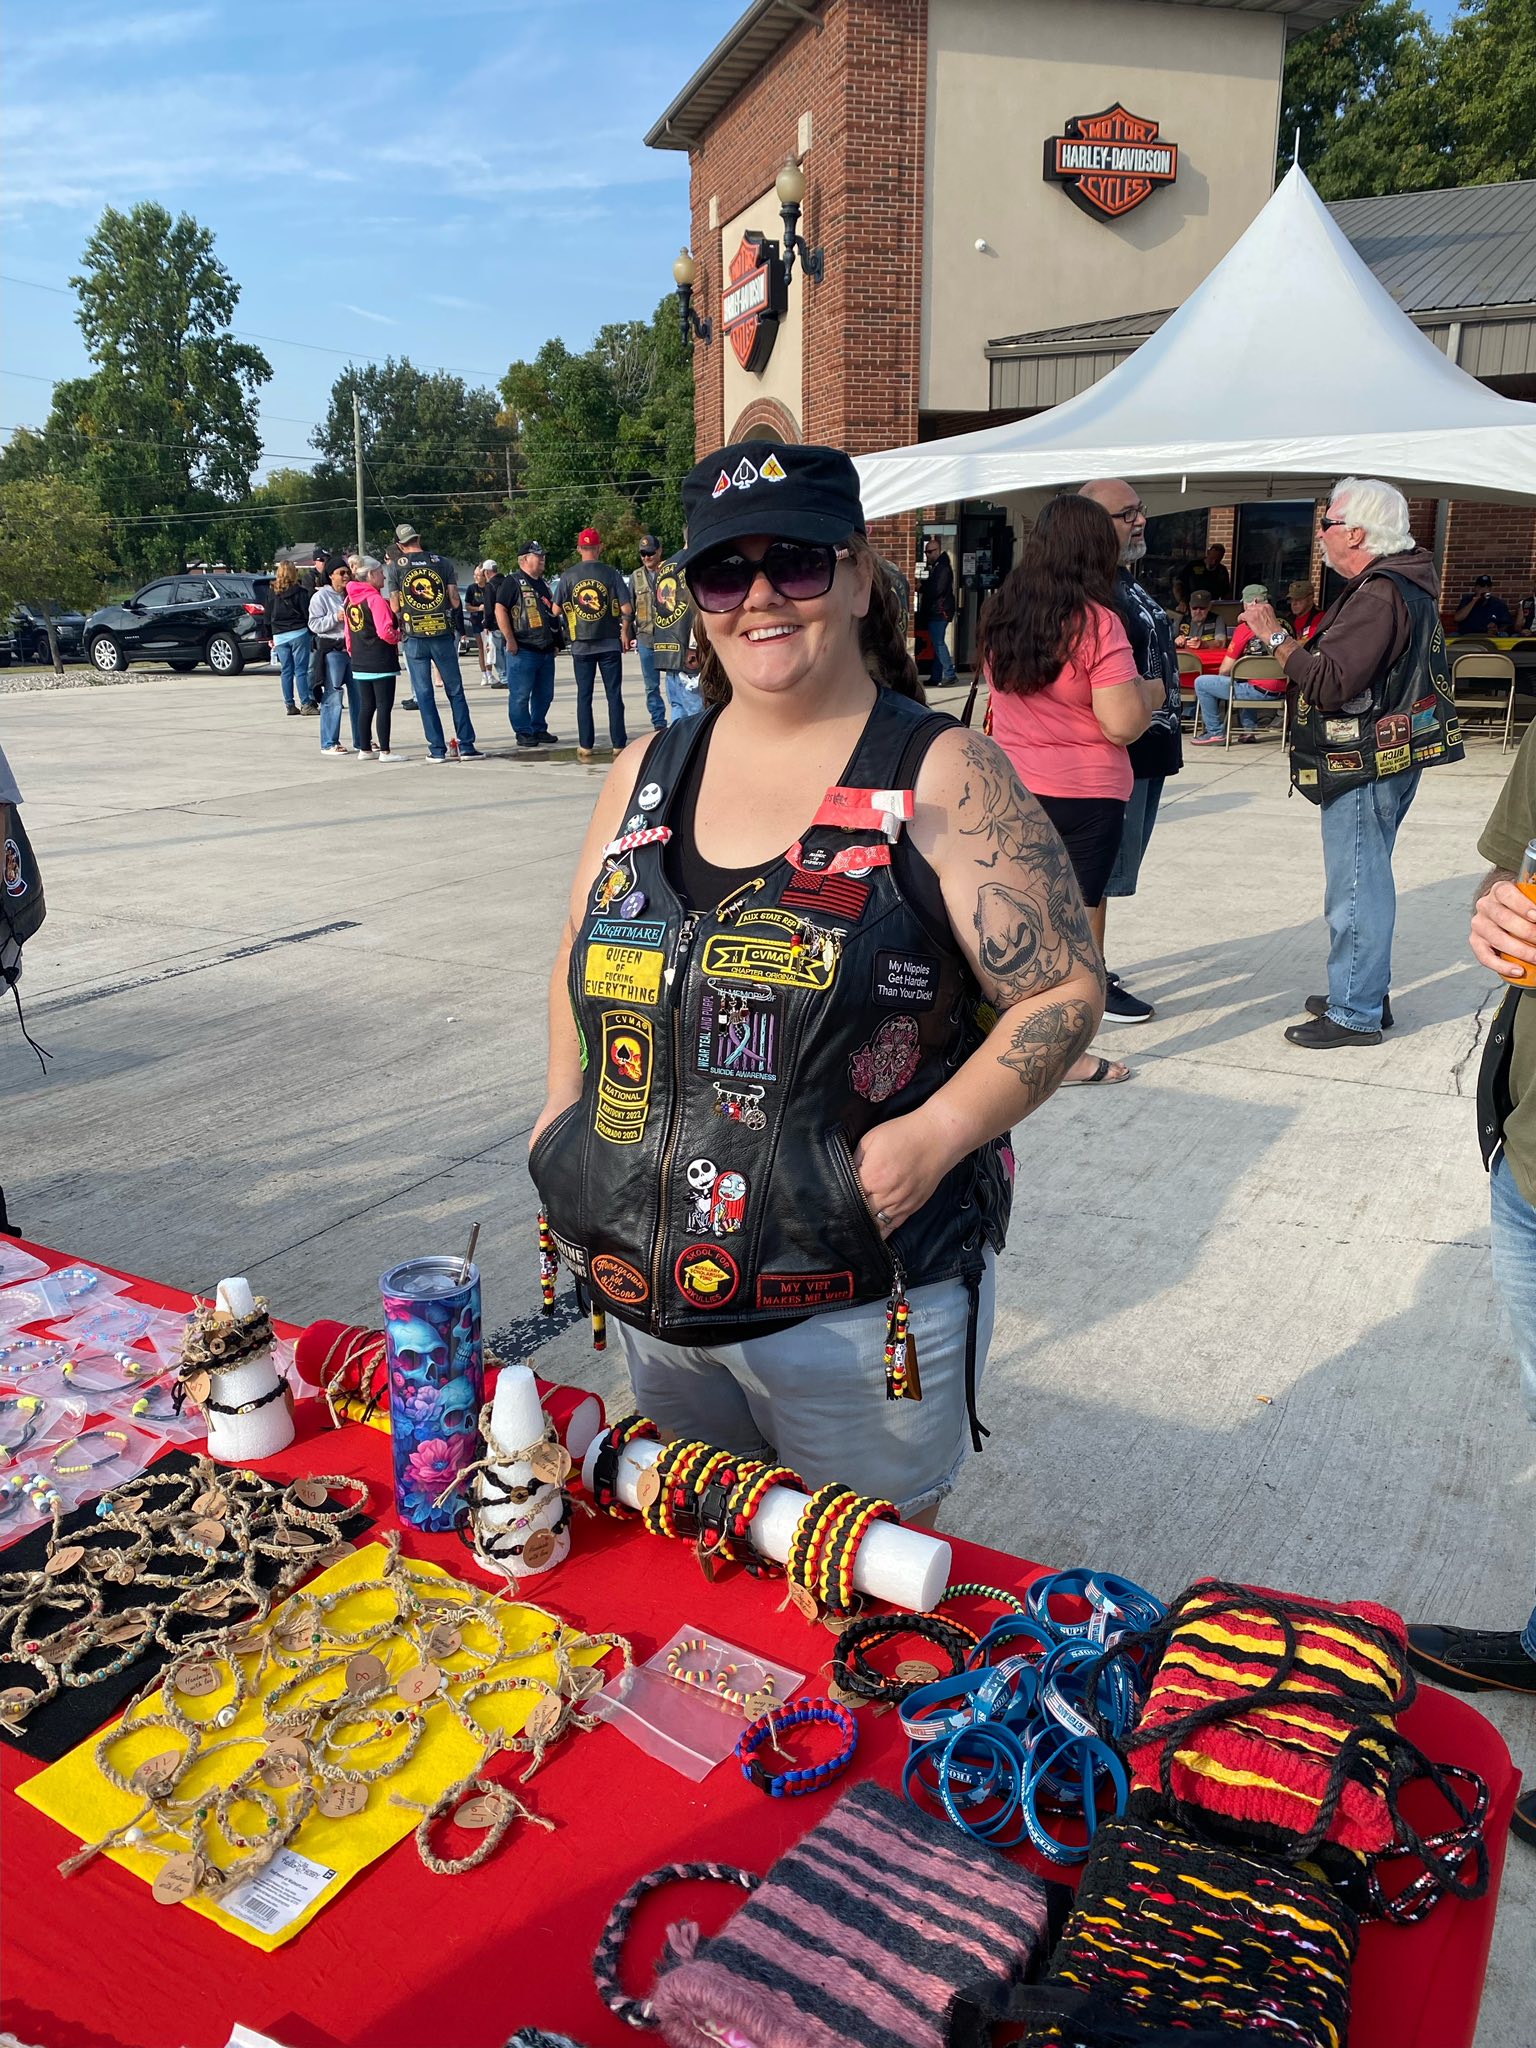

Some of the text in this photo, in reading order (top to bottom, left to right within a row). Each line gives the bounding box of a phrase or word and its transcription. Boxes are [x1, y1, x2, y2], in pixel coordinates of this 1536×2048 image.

[1089, 113, 1147, 143] MOTOR
[1062, 144, 1171, 174] HARLEY-DAVIDSON
[1087, 176, 1145, 209] CYCLES
[404, 569, 441, 587] COMBAT VETS
[656, 564, 676, 584] OMBA
[573, 579, 608, 598] COMBAT VETS
[406, 592, 443, 610] ASSOCIATION
[574, 603, 608, 620] ASSOCIATION
[1382, 747, 1405, 761] BITCH
[743, 912, 797, 928] AUX STATE REP
[606, 947, 643, 965] QUEEN
[731, 966, 797, 981] CHAPTER ORIGINAL
[889, 960, 930, 975] My Nipples
[604, 972, 634, 984] FUCKING
[887, 972, 928, 988] Get Harder
[585, 979, 656, 1003] EVERYTHING
[727, 988, 765, 999] MEMORY
[877, 984, 933, 1001] Than Your Dick!
[700, 1015, 713, 1031] AND
[699, 1031, 711, 1048] TEAL
[697, 1050, 711, 1067] WEAR
[709, 1066, 777, 1082] SUICIDE AWARENESS
[605, 1083, 641, 1101] NATIONAL
[601, 1102, 642, 1120] KENTUCKY 2022
[598, 1121, 638, 1140] COLORADO 2023
[686, 1248, 730, 1270] SKOOL FOR
[596, 1259, 644, 1290] Homegrown
[690, 1267, 725, 1281] SCHOLARSHIP
[699, 1274, 713, 1283] FUND
[780, 1280, 831, 1293] MY VET
[686, 1287, 722, 1304] SKULLIES
[762, 1295, 802, 1305] MAKES
[805, 1293, 822, 1302] ME
[190, 1681, 204, 1692] with
[413, 1680, 424, 1694] 8
[1056, 1704, 1085, 1734] VETERANS
[335, 1787, 347, 1811] Handmade
